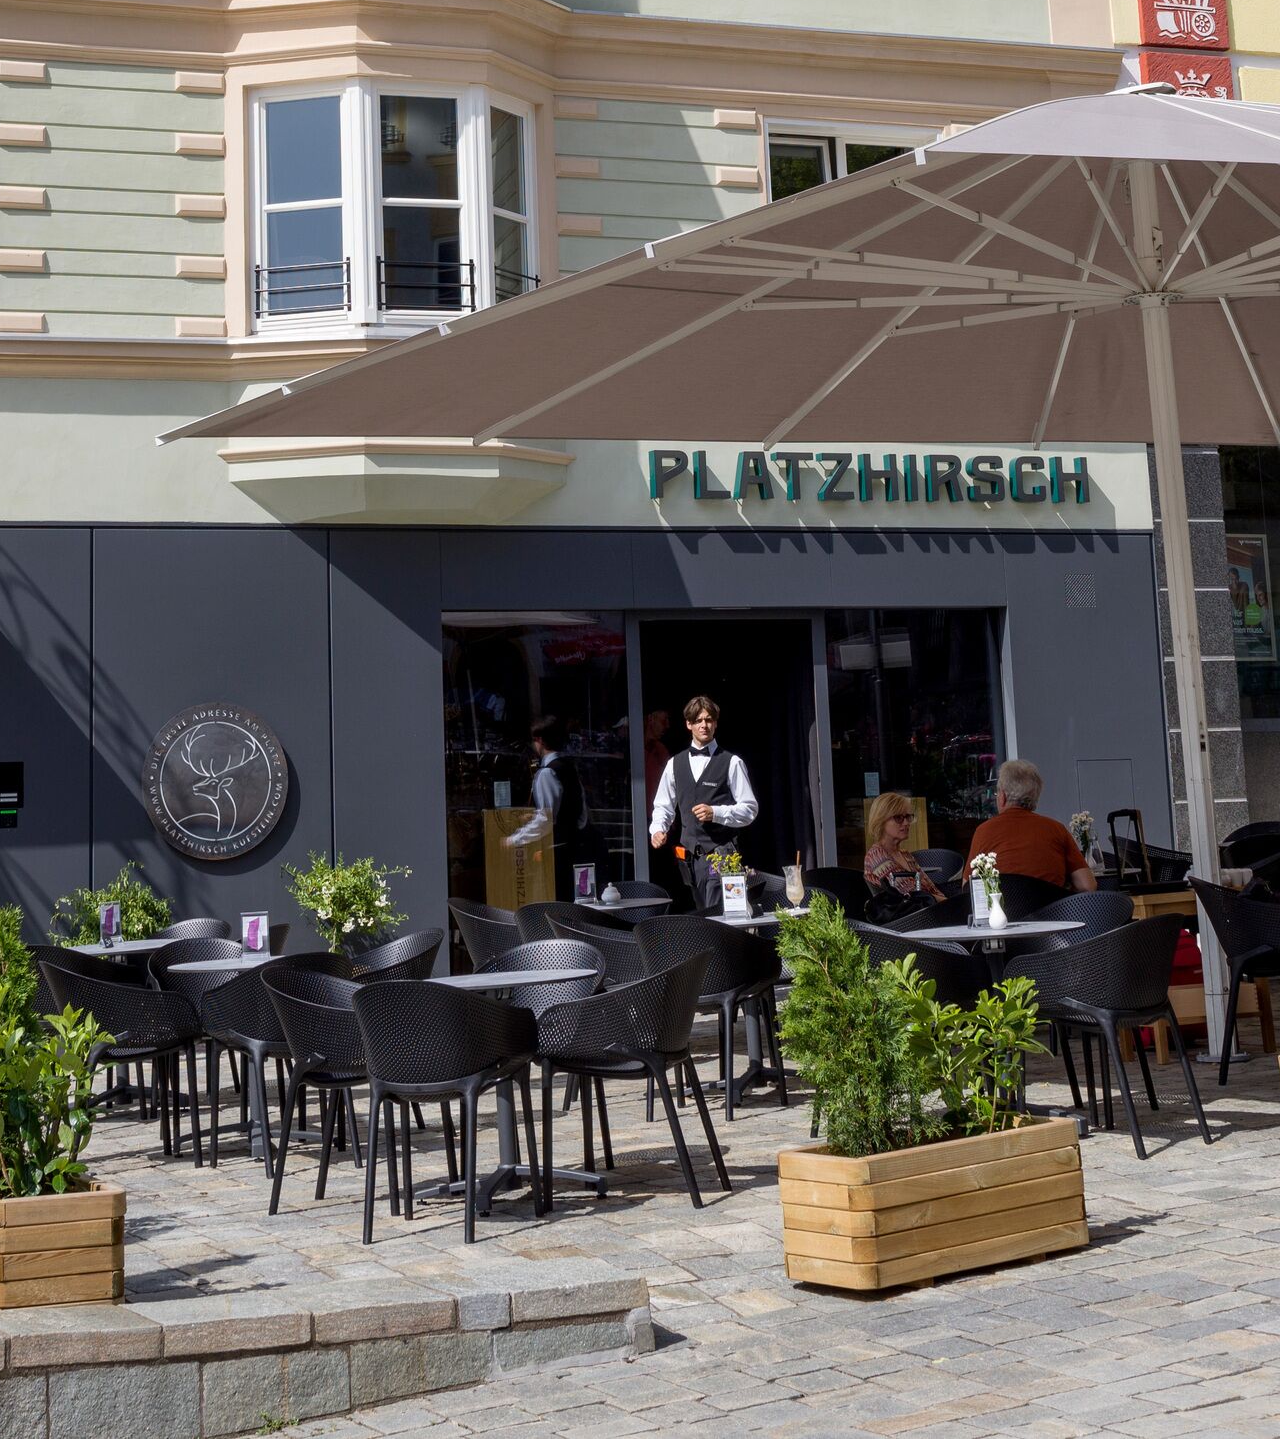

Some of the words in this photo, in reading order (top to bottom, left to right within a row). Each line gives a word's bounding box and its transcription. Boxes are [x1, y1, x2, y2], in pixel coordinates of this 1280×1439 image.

[649, 449, 1090, 504] PLATZHIRSCH
[151, 749, 162, 770] DIE
[161, 719, 188, 747] ERSTE
[192, 709, 241, 721] ADRESSE
[244, 718, 260, 732] AM
[261, 734, 281, 767] PLATZ
